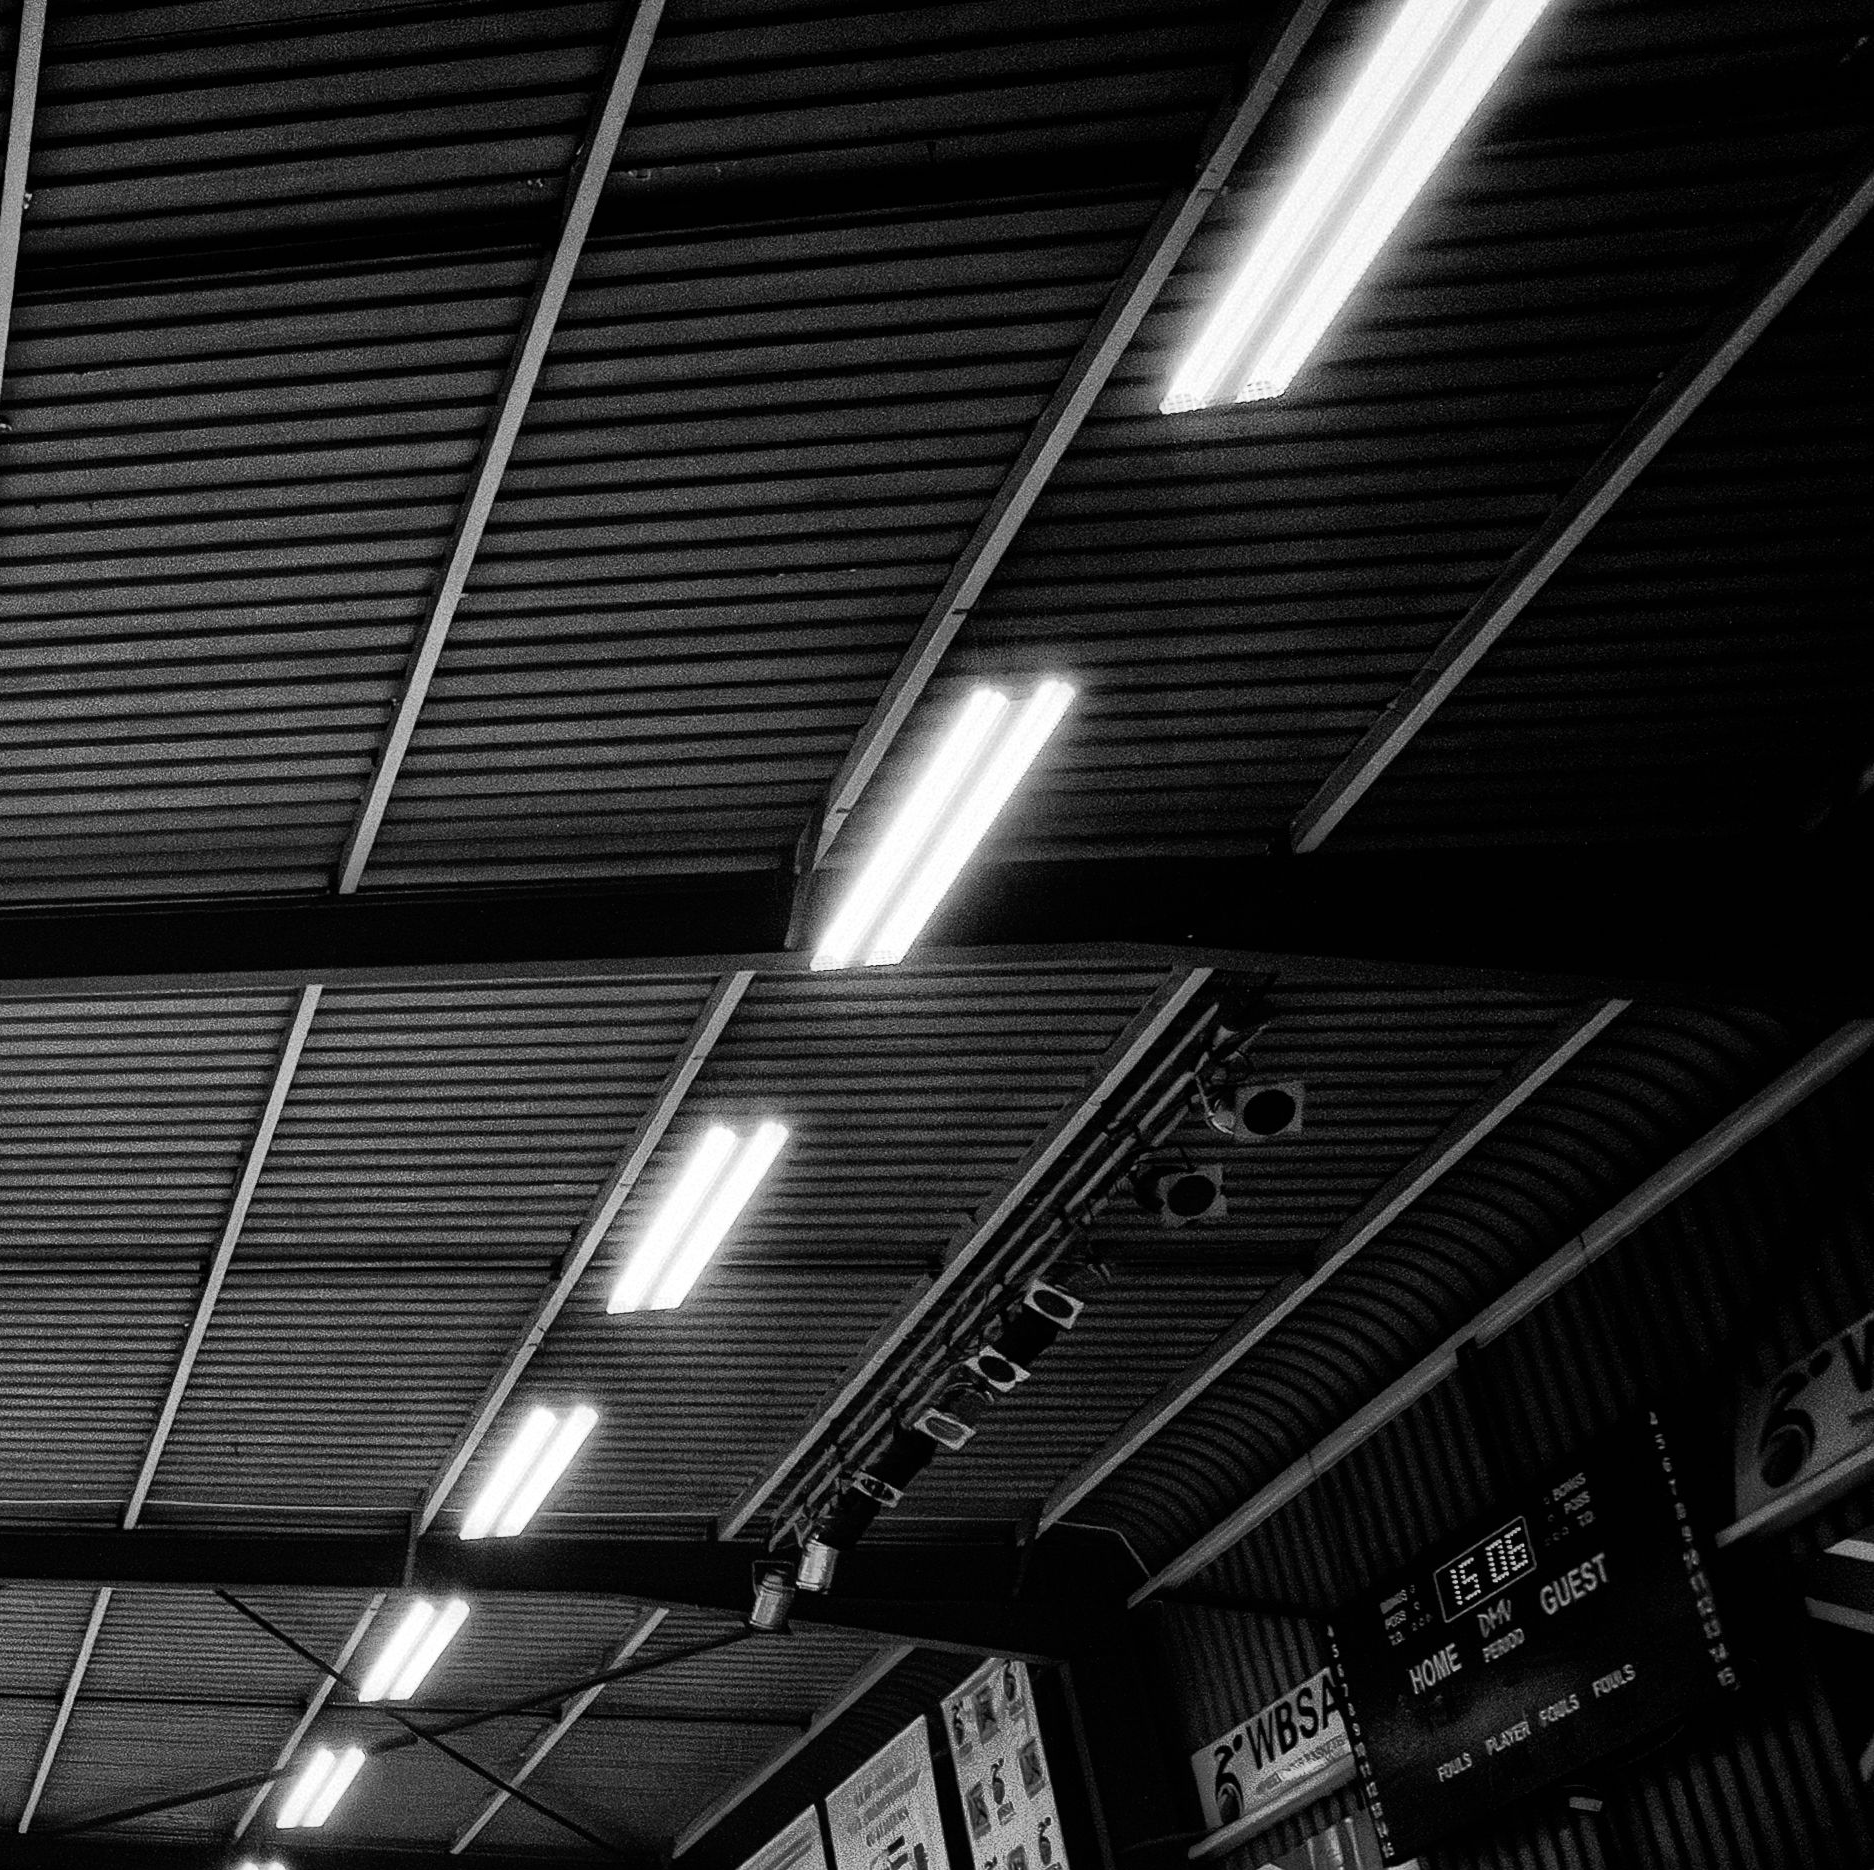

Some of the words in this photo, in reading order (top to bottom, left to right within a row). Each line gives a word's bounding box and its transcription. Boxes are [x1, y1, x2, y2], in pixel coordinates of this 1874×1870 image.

[1539, 1552, 1609, 1615] GUEST
[1408, 1642, 1462, 1695] HOME
[1485, 1721, 1532, 1757] PLAYER
[1436, 1752, 1473, 1783] FOULS
